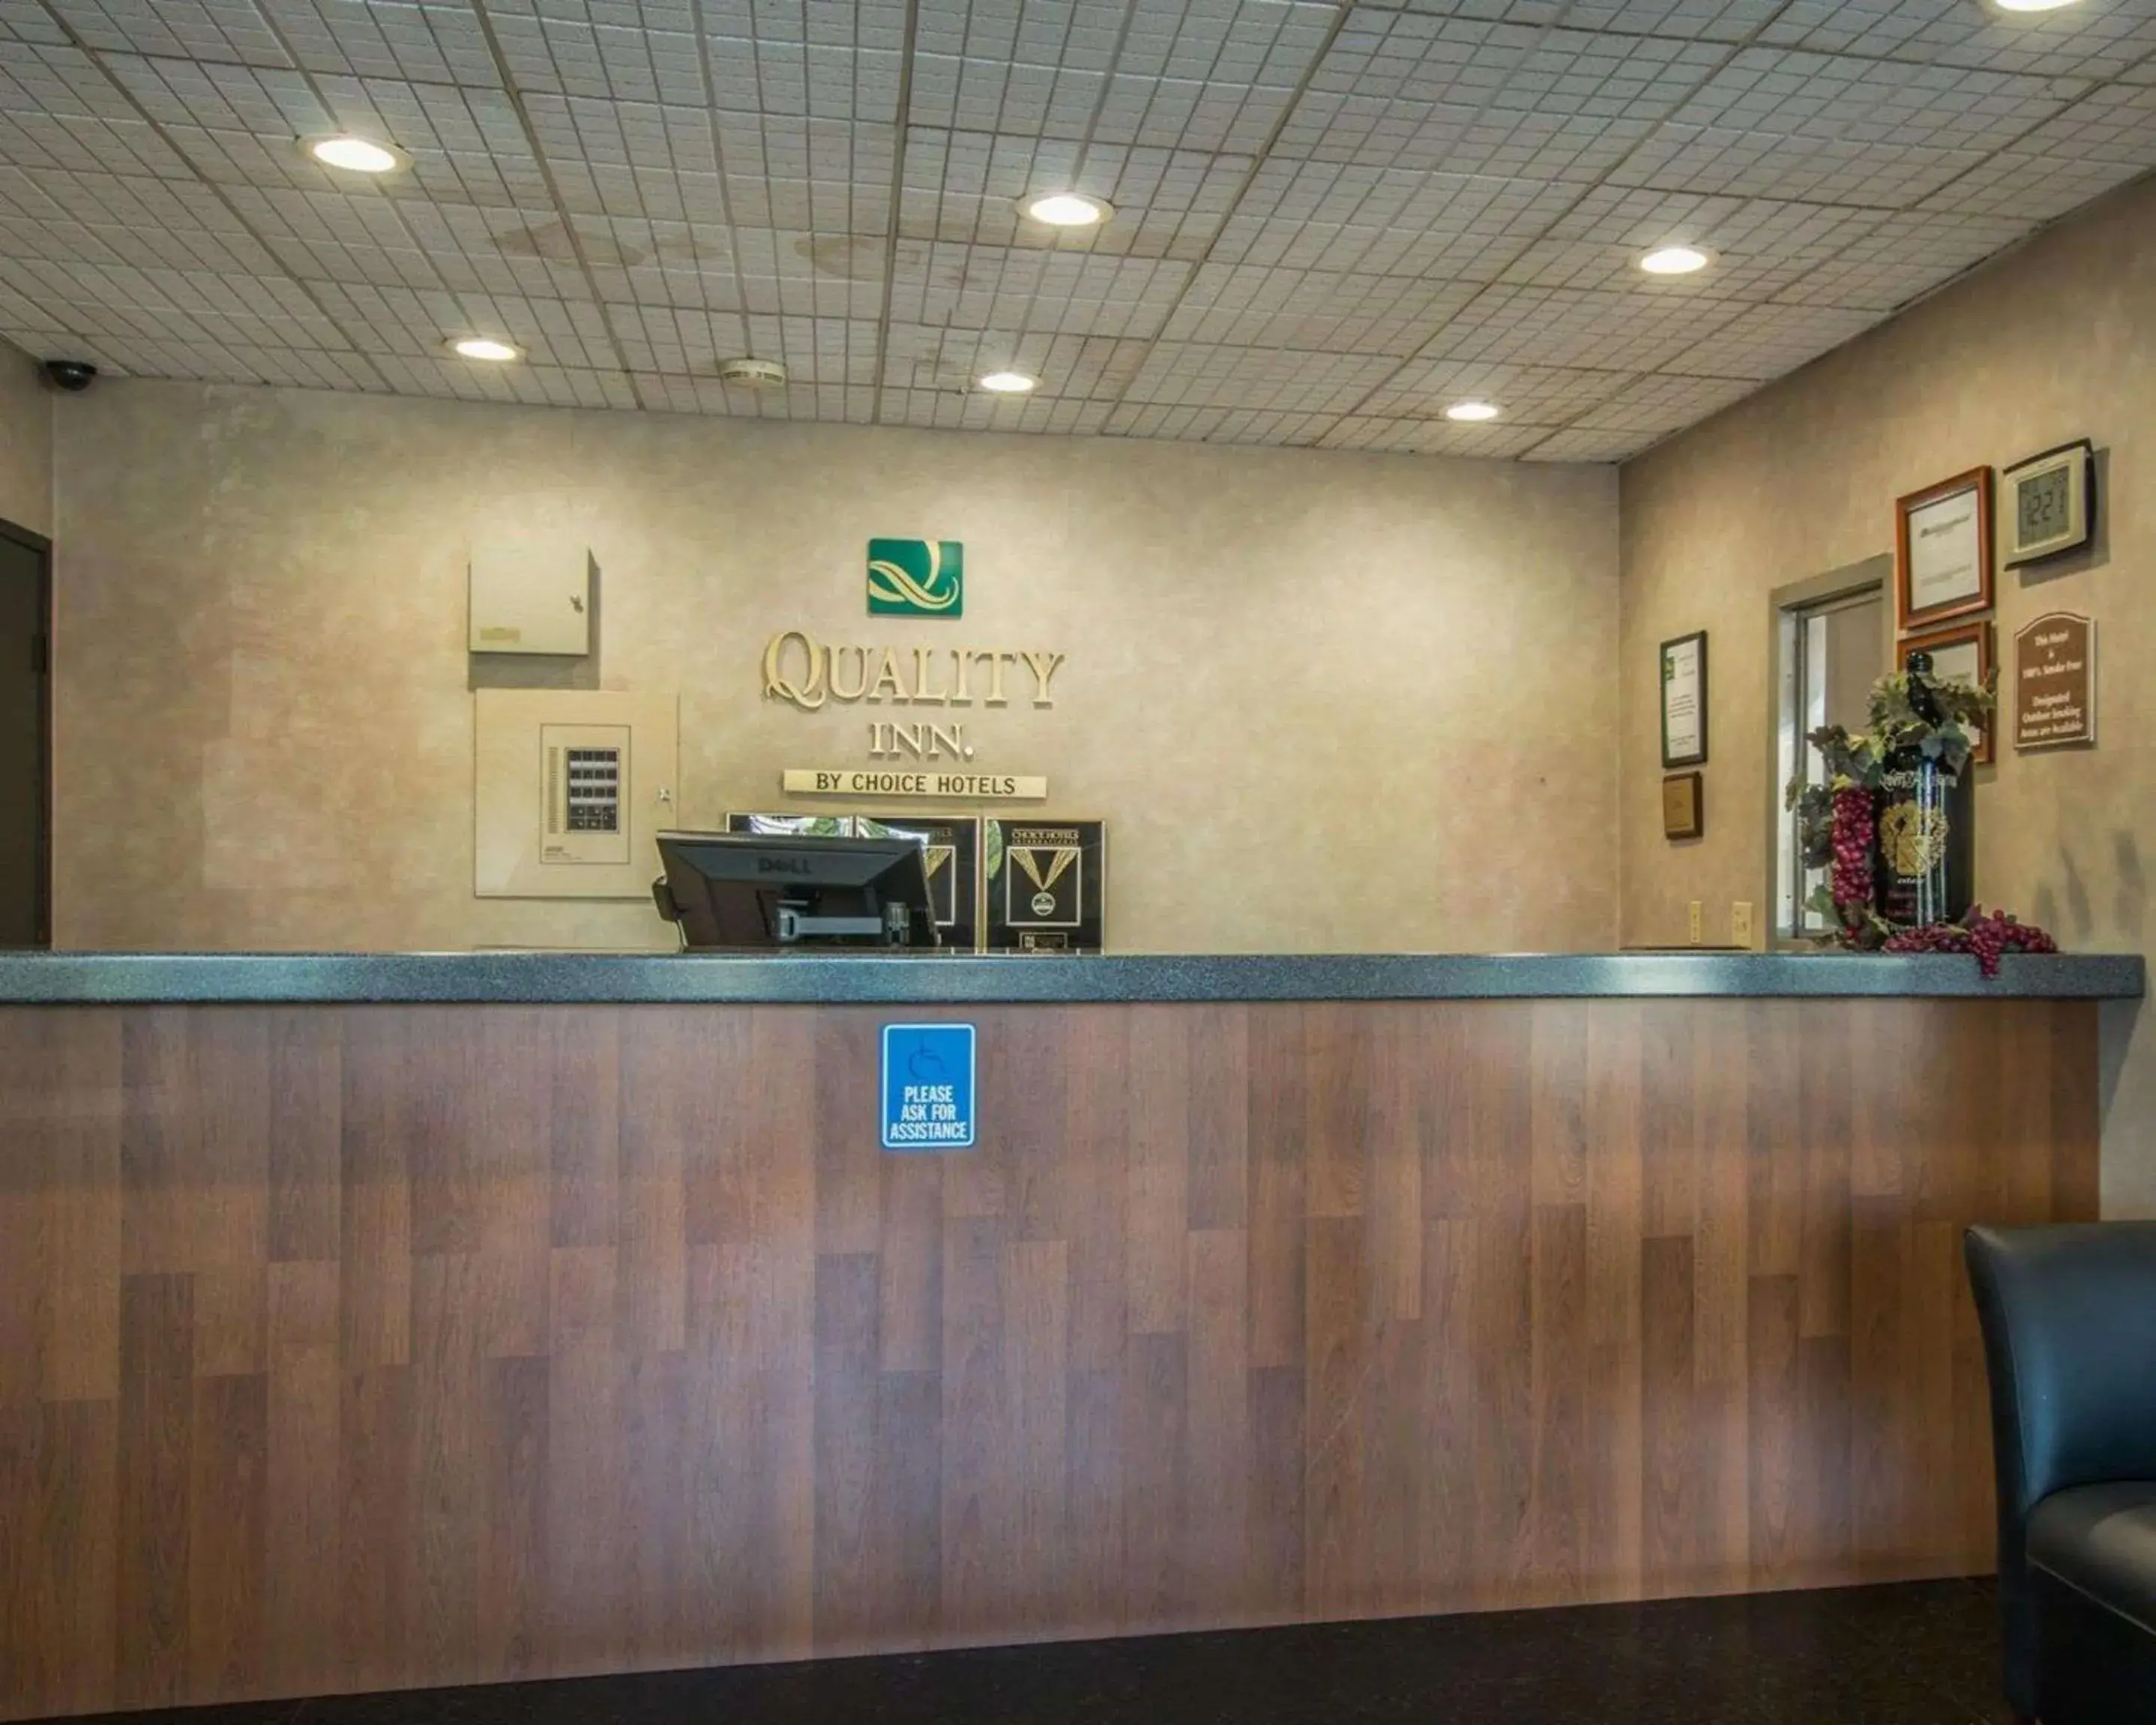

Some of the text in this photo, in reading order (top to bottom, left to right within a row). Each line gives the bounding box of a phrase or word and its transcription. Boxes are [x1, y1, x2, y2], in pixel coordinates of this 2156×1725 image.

[763, 631, 1065, 711] QUALITY
[816, 773, 1016, 795] BY CHOICE HOTELS
[904, 1086, 953, 1103] PLEASE
[901, 1104, 956, 1122] ASK FOR
[889, 1122, 967, 1140] ASSISTANCE
